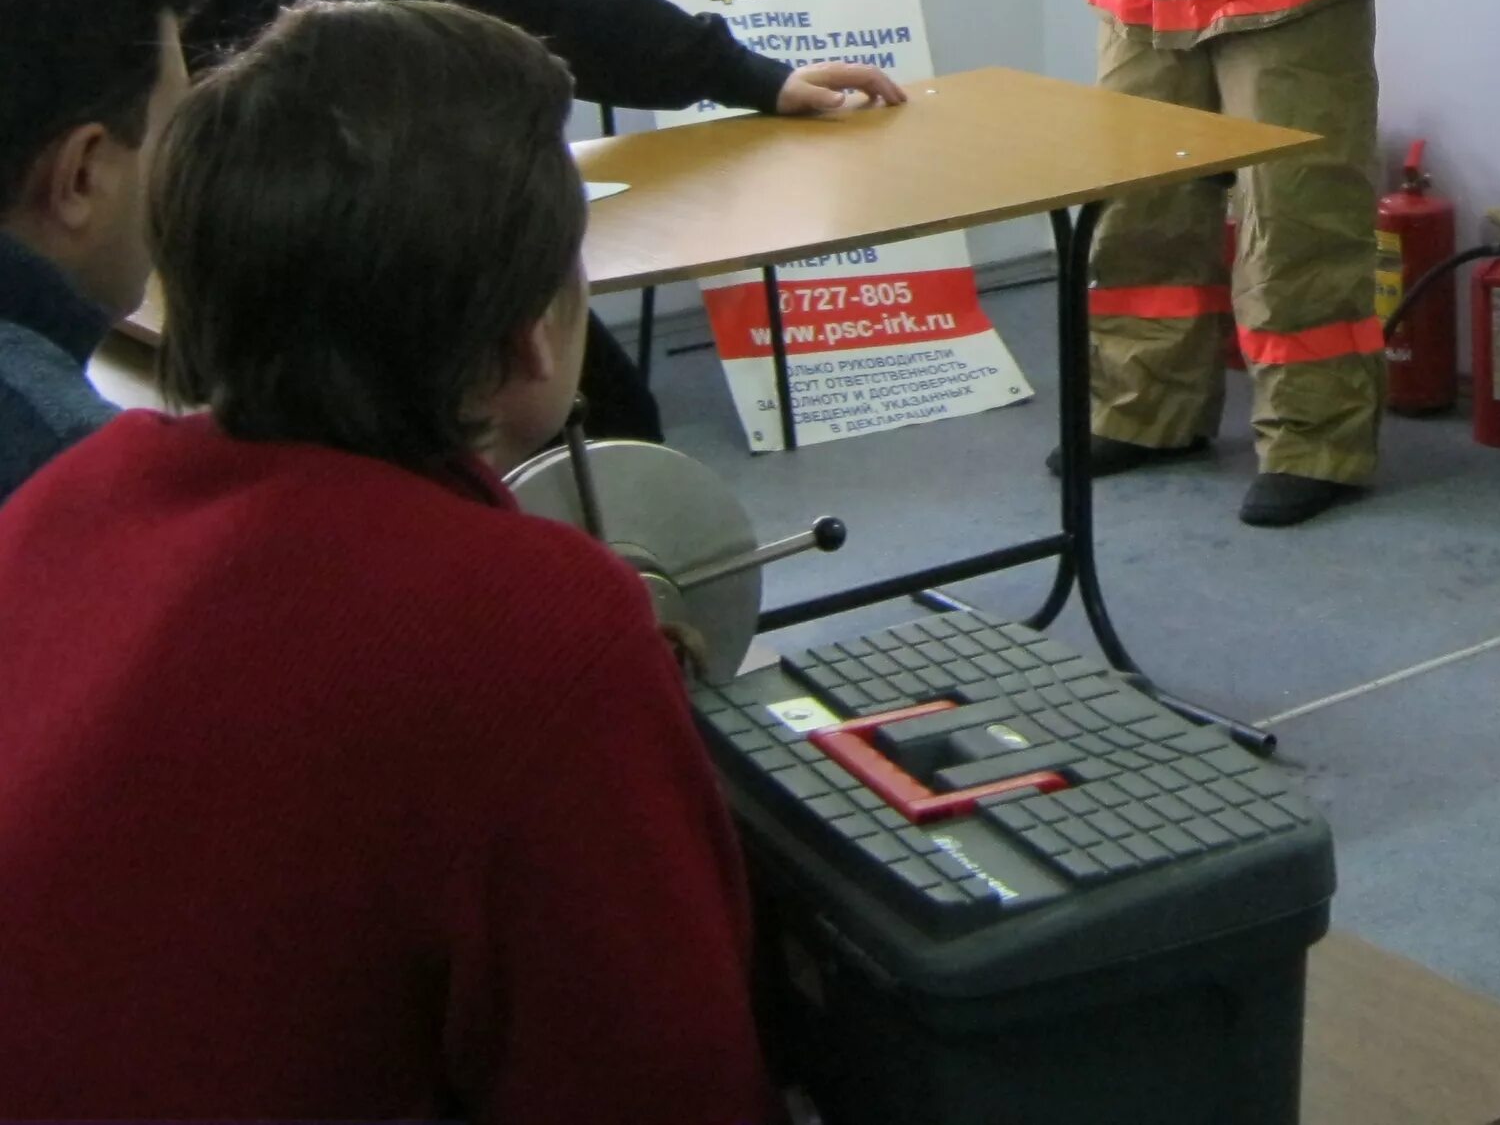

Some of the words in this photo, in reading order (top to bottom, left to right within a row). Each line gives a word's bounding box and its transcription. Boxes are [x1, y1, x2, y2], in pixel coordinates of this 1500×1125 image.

[726, 11, 811, 30] ЧЕНИЕ
[747, 25, 912, 53] НСУЛЬТАЦИЯ
[796, 281, 912, 312] 727-805
[838, 348, 956, 371] РУКОВОДИТЕЛИ
[757, 399, 776, 412] ЗА
[791, 391, 849, 409] ОЛНОТУ
[854, 390, 864, 402] И
[870, 364, 999, 400] ДОСТОВЕРНОСТЬ
[826, 360, 968, 389] ОТВЕТСТВЕННОСТЬ
[884, 385, 976, 413] УКАЗАННЫХ
[830, 423, 841, 434] В
[846, 403, 949, 433] ДЕКЛАРАЦИИ
